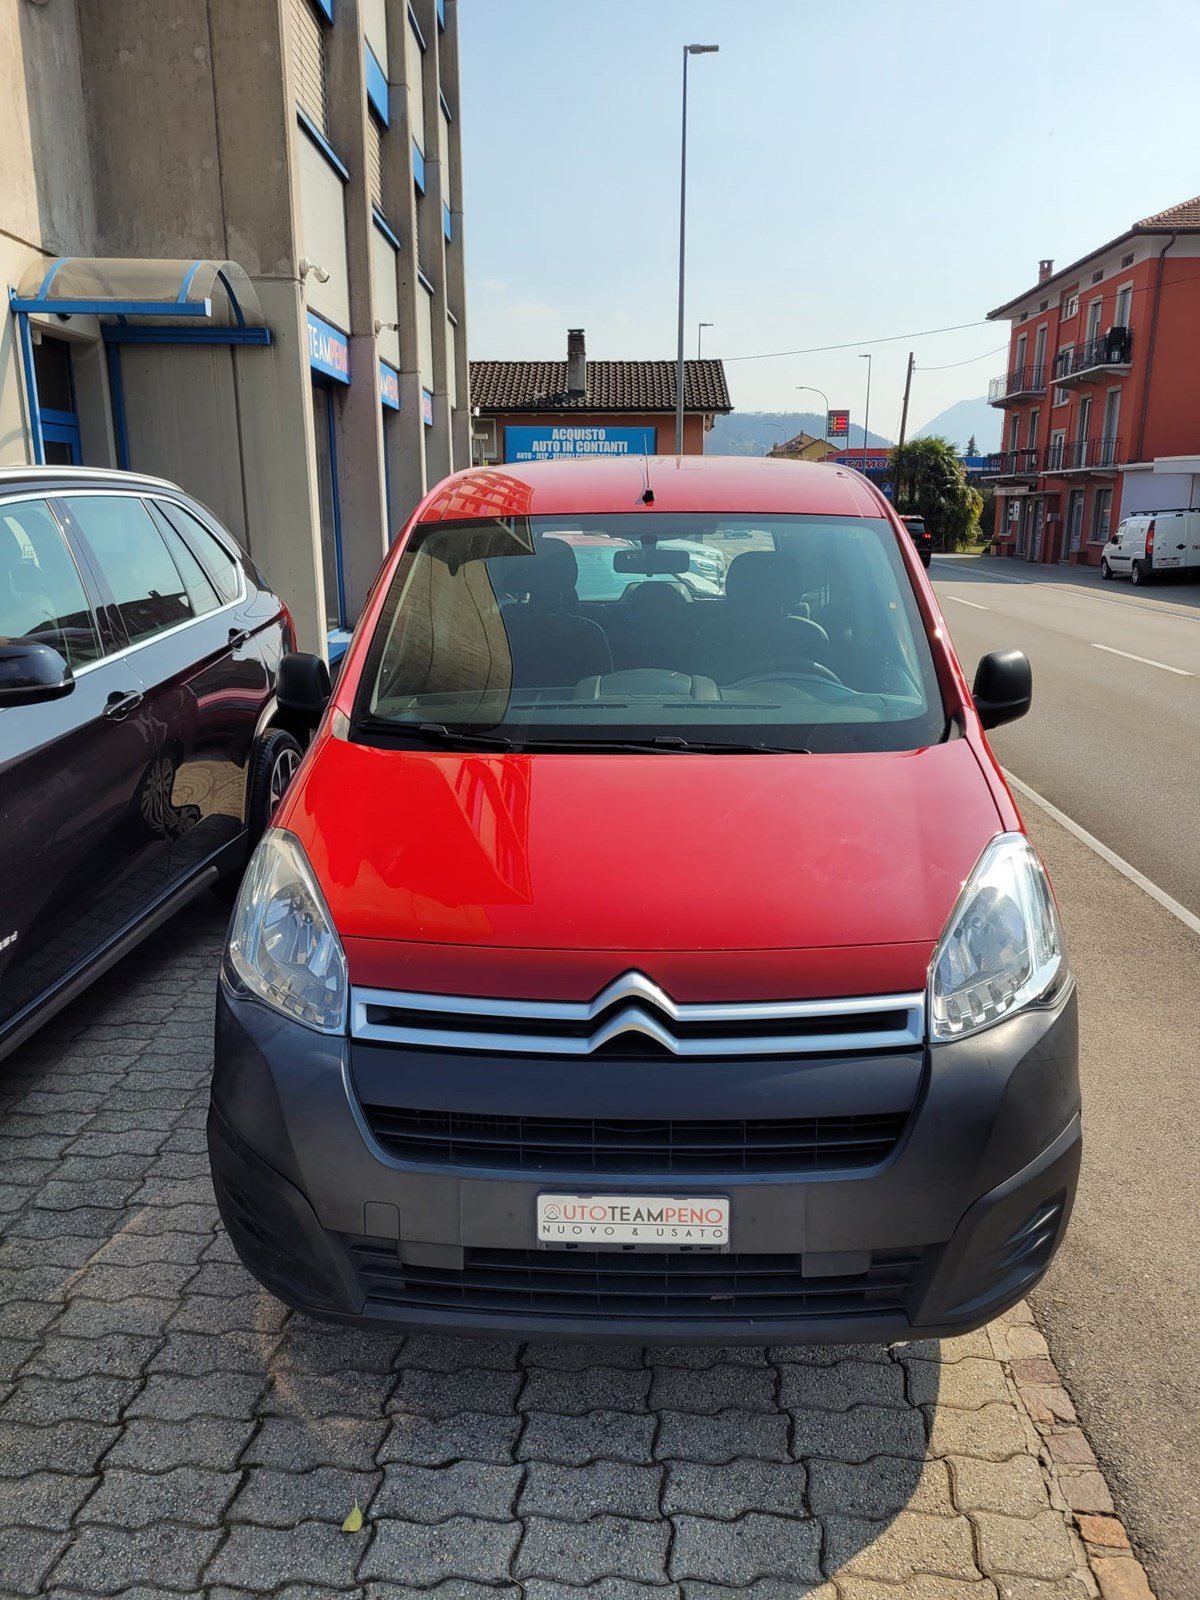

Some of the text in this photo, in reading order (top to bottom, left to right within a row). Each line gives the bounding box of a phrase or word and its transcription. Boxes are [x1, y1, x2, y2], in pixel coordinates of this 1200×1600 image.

[552, 429, 605, 441] ACQUISTO
[532, 441, 628, 453] AUTO IN CONTANTI
[543, 1225, 723, 1238] NUOVO & USATO
